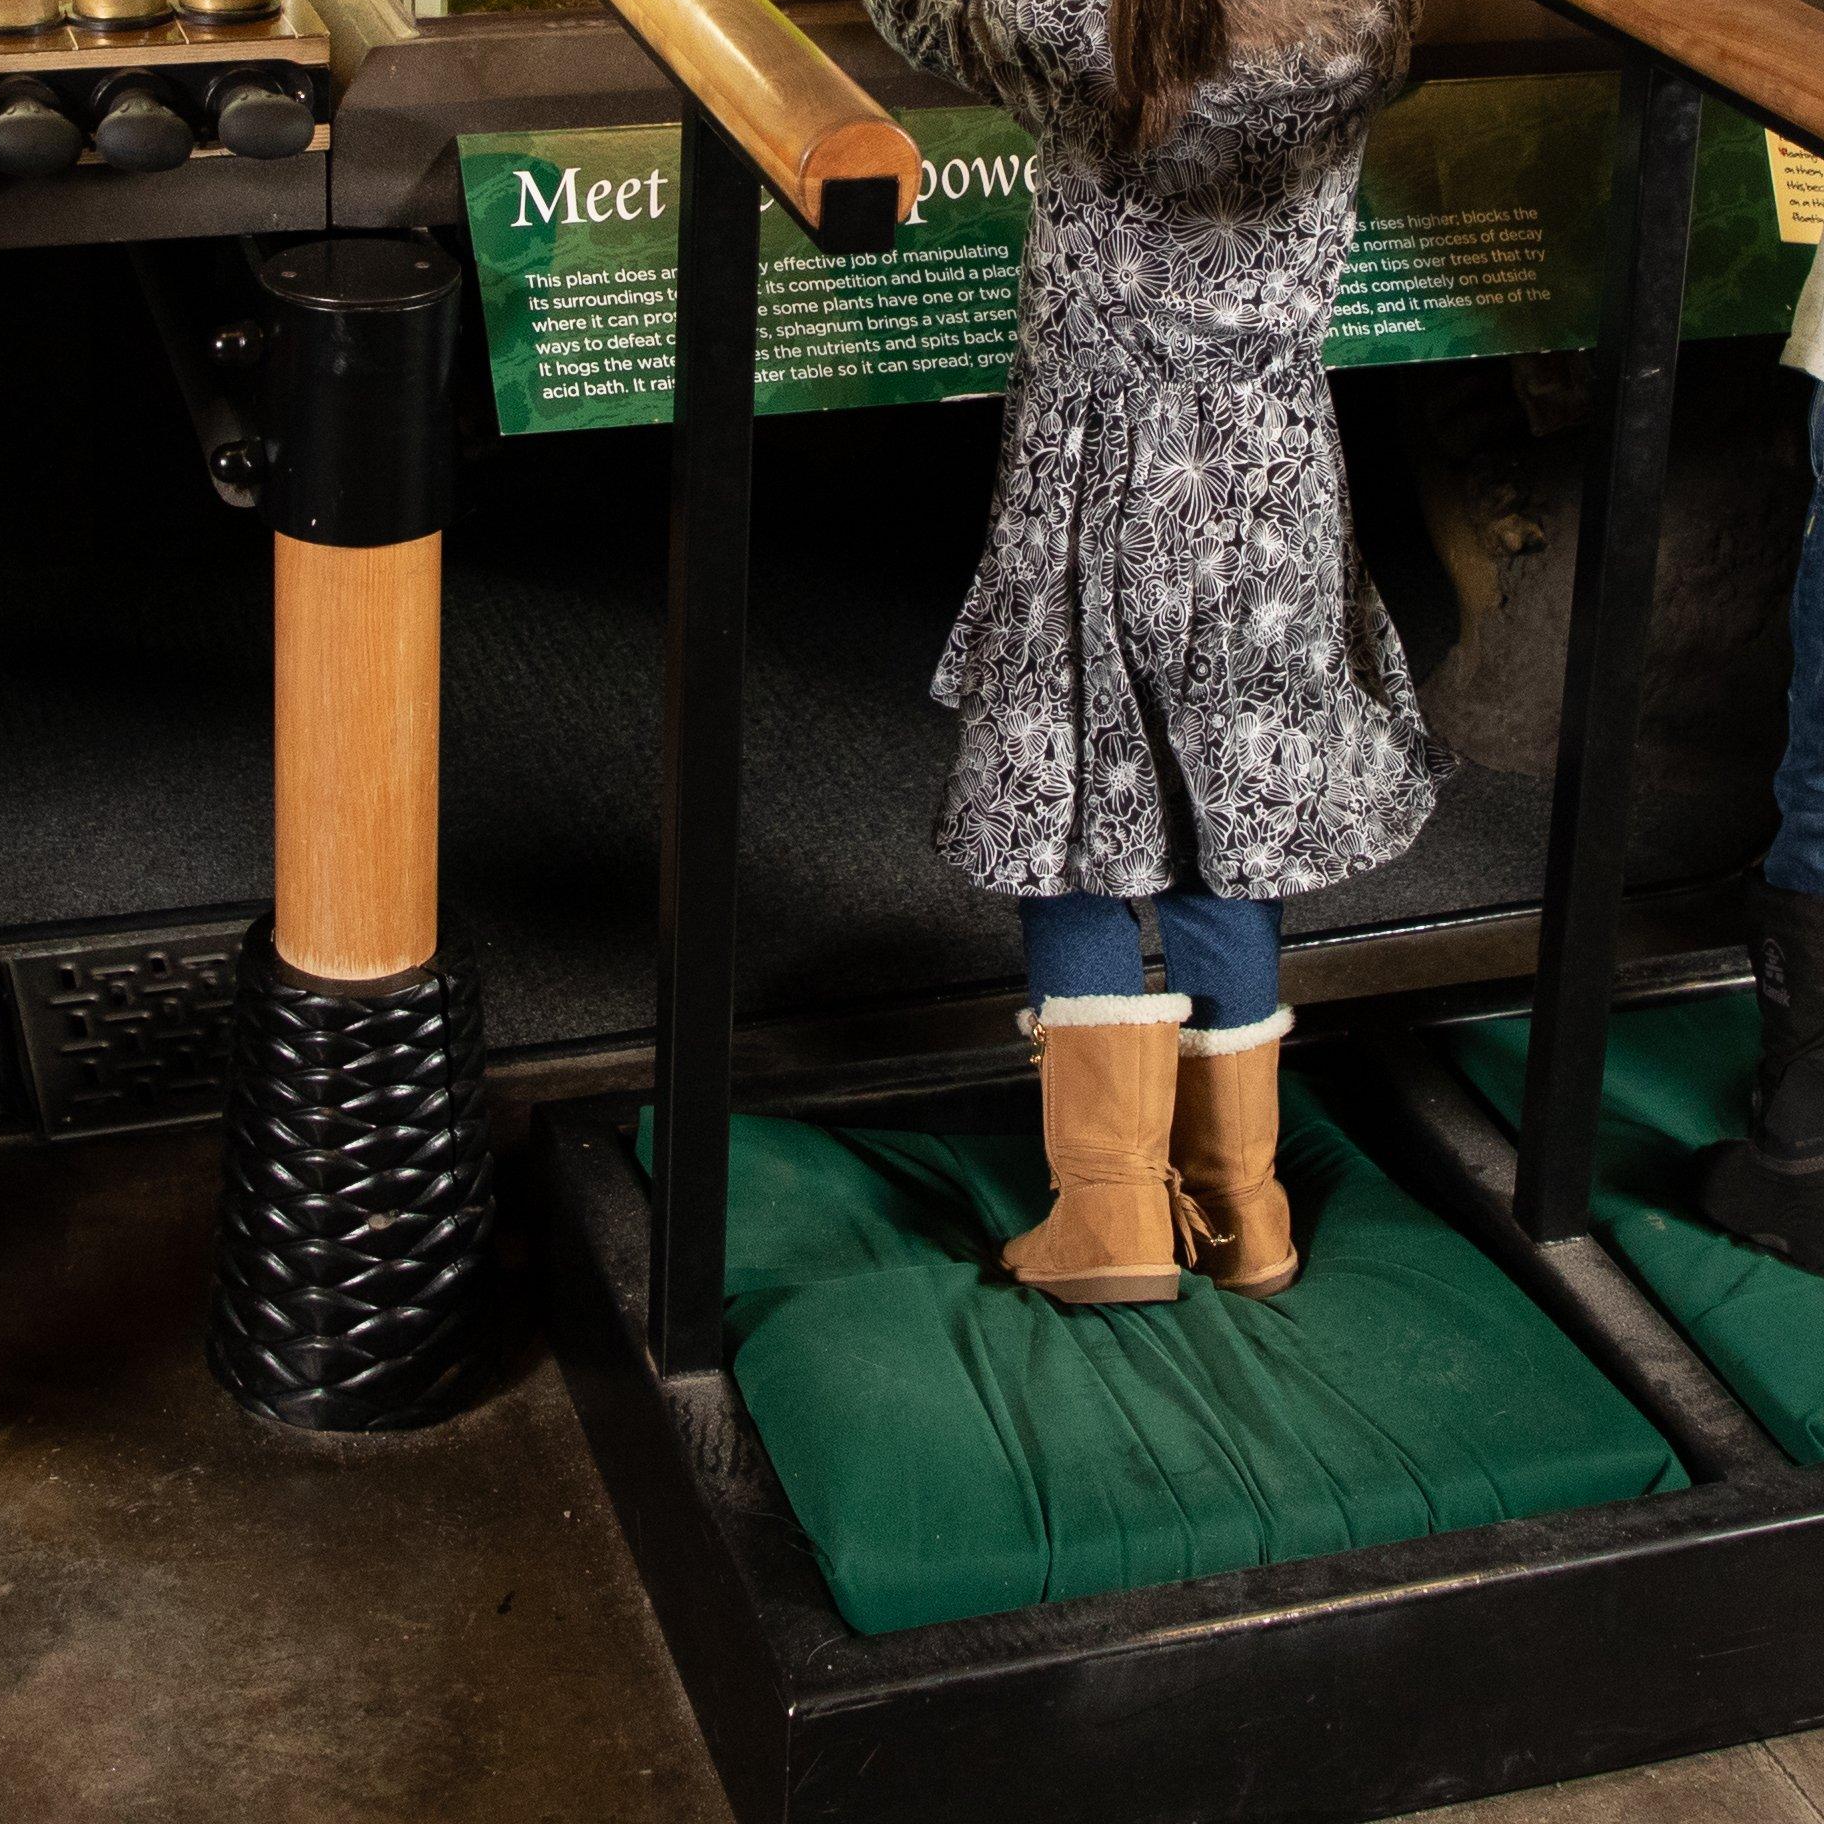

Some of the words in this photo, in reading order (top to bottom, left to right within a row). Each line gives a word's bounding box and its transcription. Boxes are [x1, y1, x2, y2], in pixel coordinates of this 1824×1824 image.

[510, 167, 669, 227] Meet
[524, 273, 562, 289] This
[565, 270, 611, 289] plant
[613, 269, 657, 284] does
[773, 254, 847, 273] effective
[850, 252, 878, 270] job
[880, 249, 899, 266] of
[902, 244, 1010, 263] manipulating
[1379, 257, 1411, 273] tips
[1412, 256, 1446, 269] over
[1449, 253, 1488, 266] trees
[1490, 249, 1520, 263] that
[1524, 248, 1545, 262] try
[531, 316, 587, 333] where
[590, 314, 604, 329] it
[607, 314, 640, 328] can
[772, 301, 819, 316] some
[822, 295, 875, 315] plants
[876, 293, 919, 308] have
[921, 291, 954, 305] one
[957, 290, 975, 303] or
[978, 287, 1012, 301] two
[1342, 321, 1371, 337] this
[1373, 318, 1426, 337] planet.
